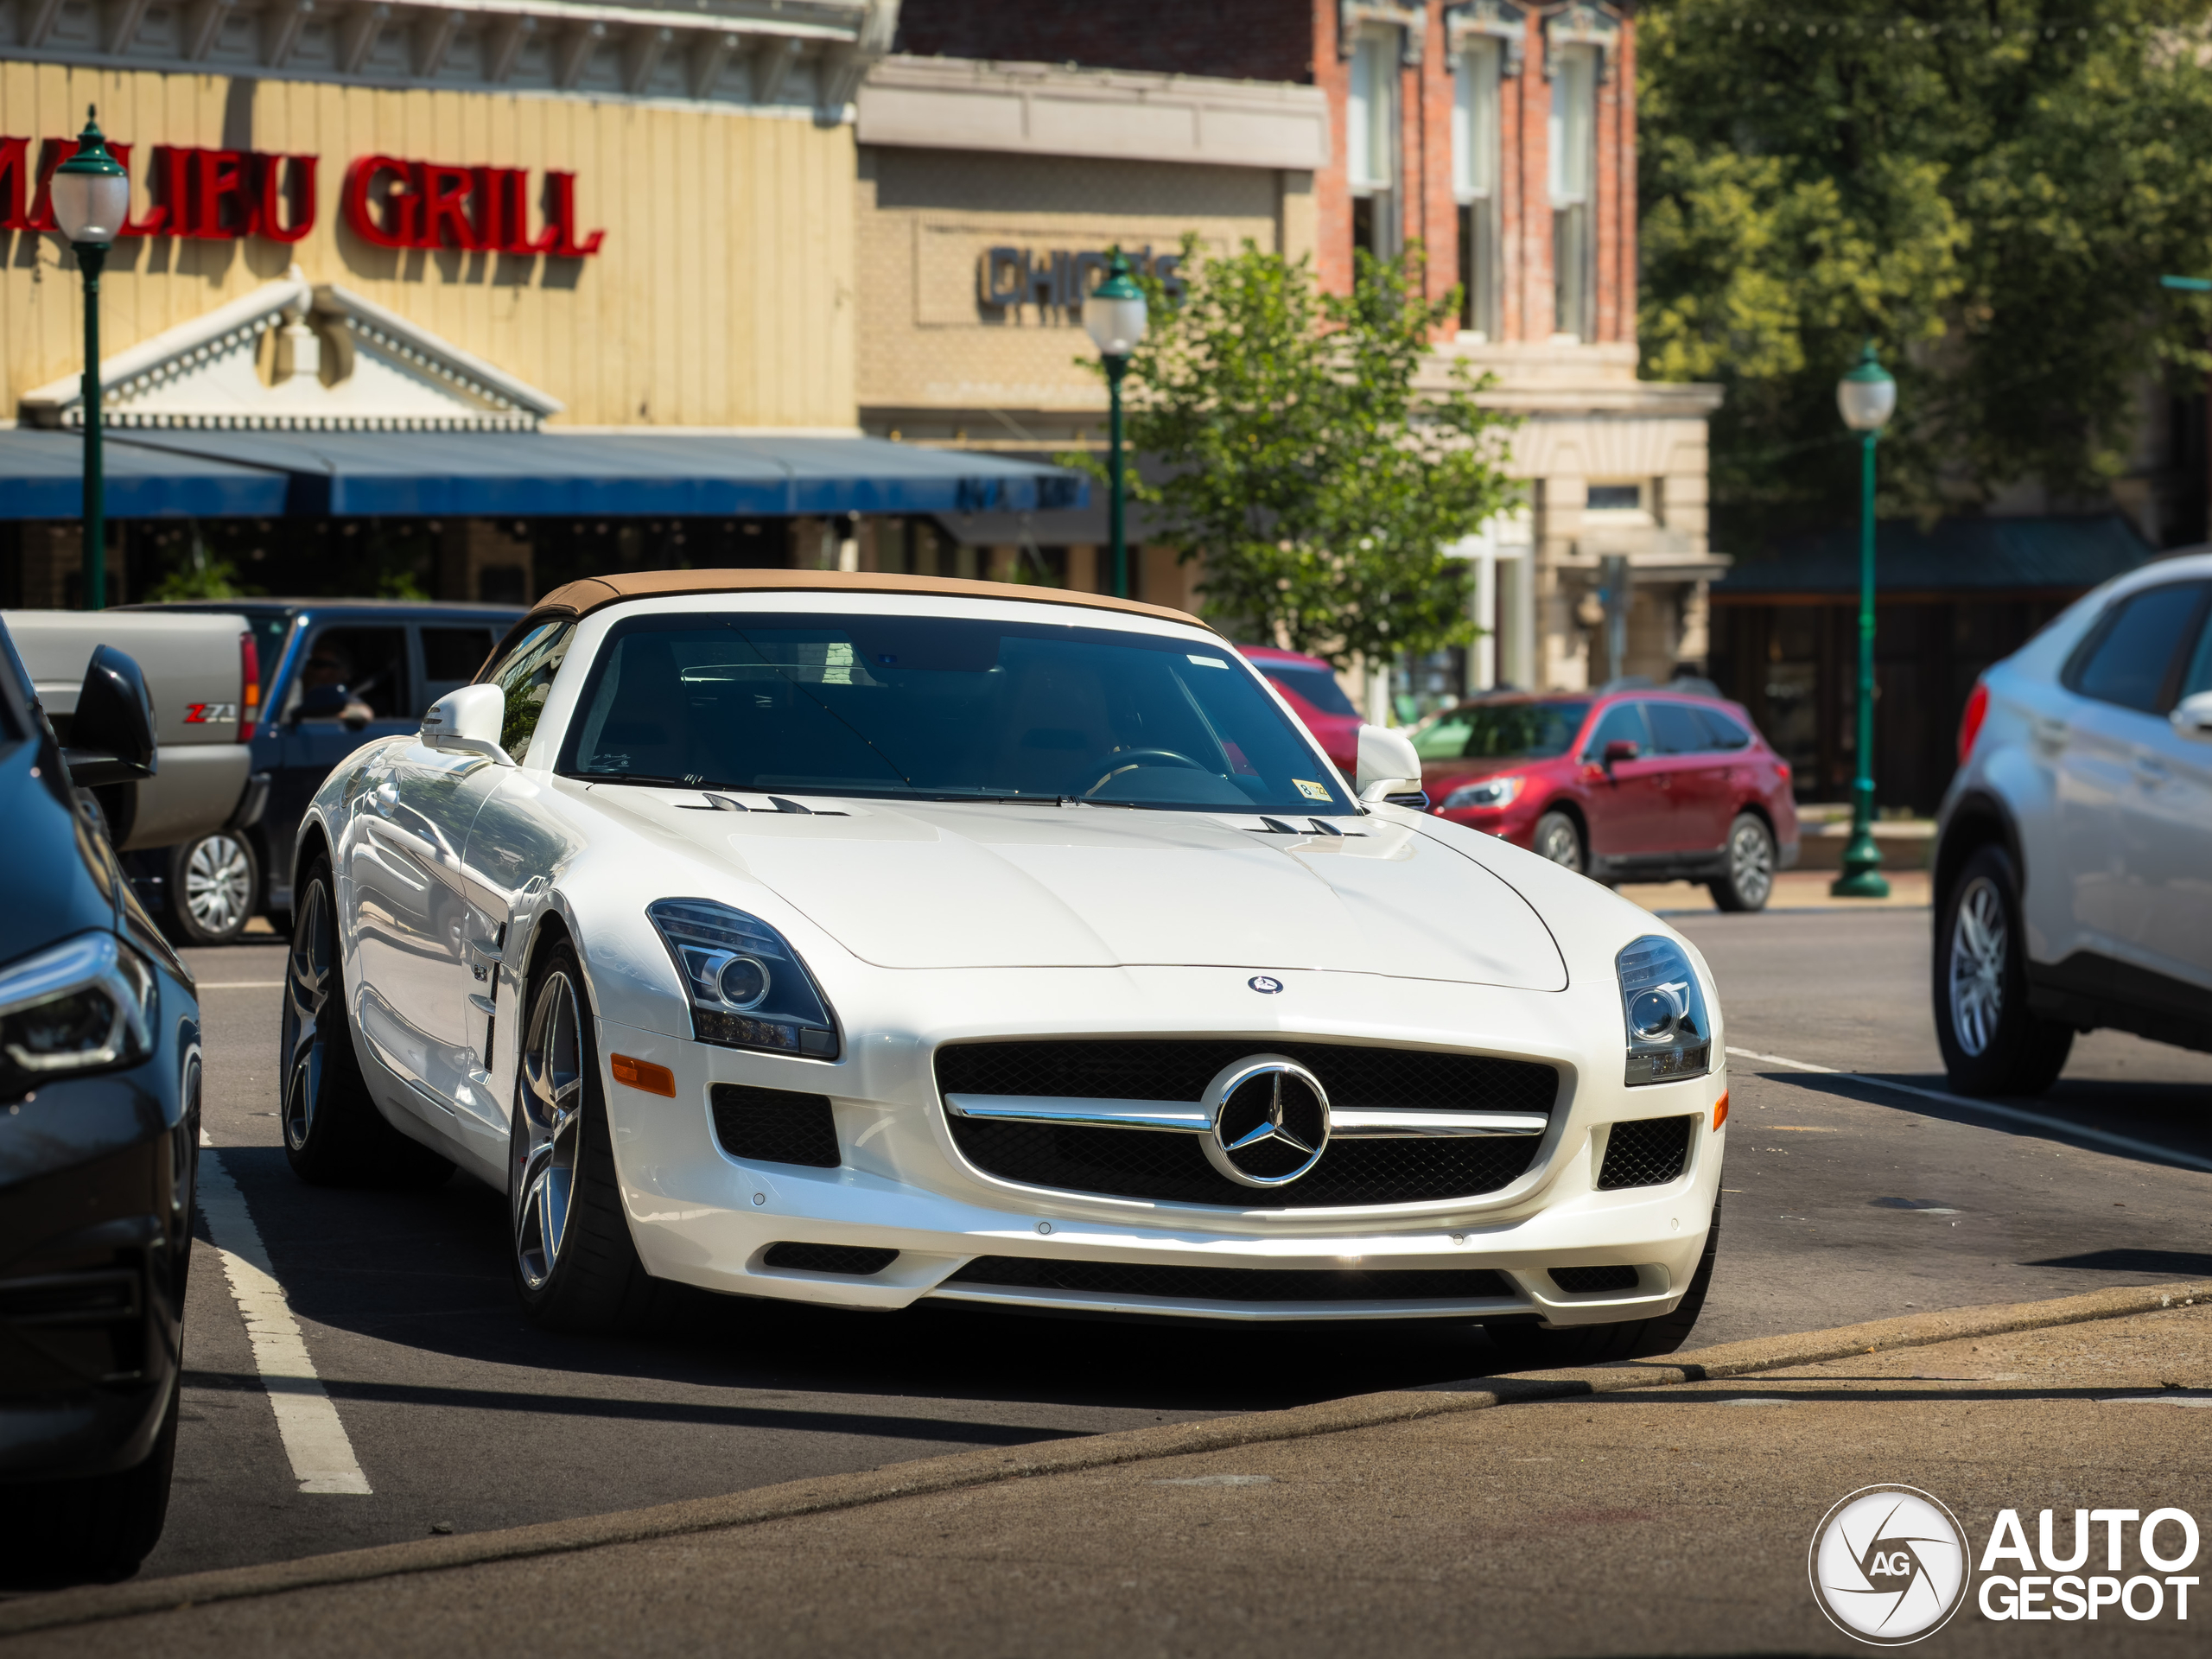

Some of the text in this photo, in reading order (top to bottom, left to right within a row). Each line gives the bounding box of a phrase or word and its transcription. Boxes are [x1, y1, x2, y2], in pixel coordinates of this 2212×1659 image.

[342, 153, 607, 256] GRILL
[185, 703, 237, 723] Z71
[1300, 784, 1312, 795] 8
